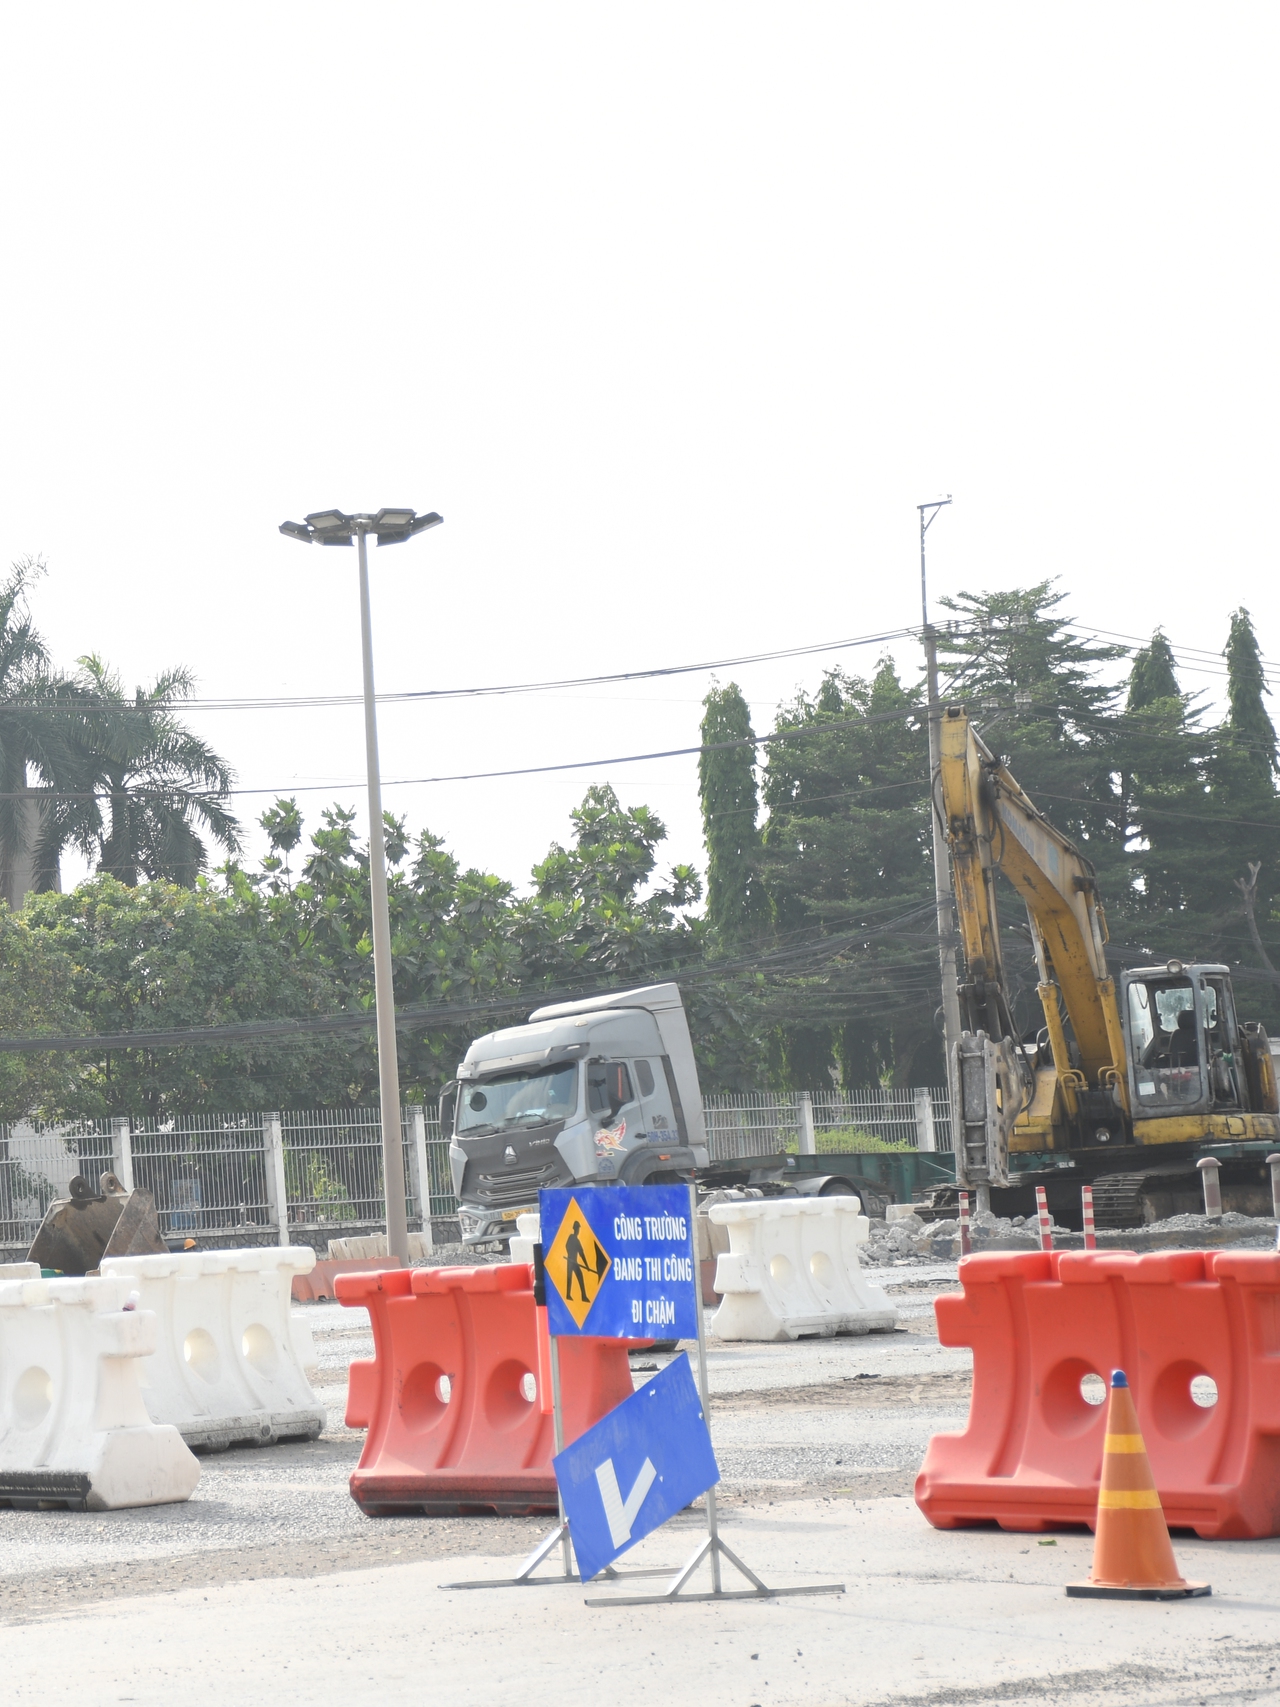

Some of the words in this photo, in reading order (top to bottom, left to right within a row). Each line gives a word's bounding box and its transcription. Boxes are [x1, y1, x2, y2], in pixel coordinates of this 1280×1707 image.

[614, 1213, 642, 1240] CÔNG
[644, 1211, 687, 1241] TRƯỜNG
[613, 1257, 642, 1281] ĐANG
[644, 1257, 661, 1281] THI
[664, 1254, 692, 1282] CÔNG
[631, 1300, 642, 1323] ĐI
[646, 1296, 675, 1328] CHẬM
